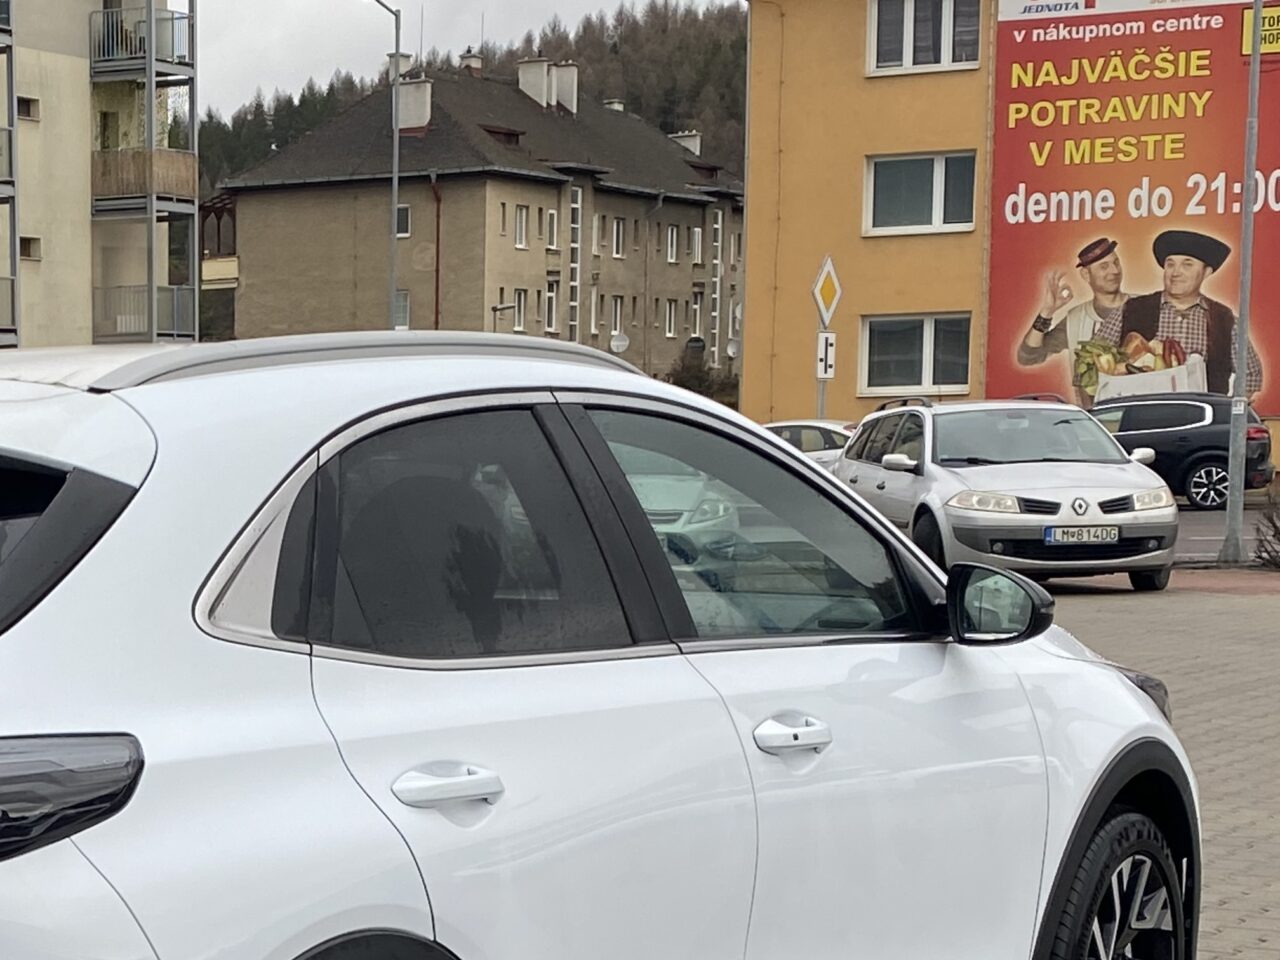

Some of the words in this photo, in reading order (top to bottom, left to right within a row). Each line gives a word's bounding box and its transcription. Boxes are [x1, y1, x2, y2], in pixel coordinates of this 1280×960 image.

[1020, 2, 1079, 14] JEDNOTA
[1013, 30, 1026, 42] v
[1032, 18, 1145, 42] nákupnom
[1152, 13, 1224, 32] centre
[1010, 46, 1212, 88] NAJVÄČŠIE
[1007, 91, 1213, 128] POTRAVINY
[1029, 141, 1053, 166] V
[1063, 133, 1186, 165] MESTE
[1005, 183, 1115, 224] denne
[1127, 177, 1173, 219] do
